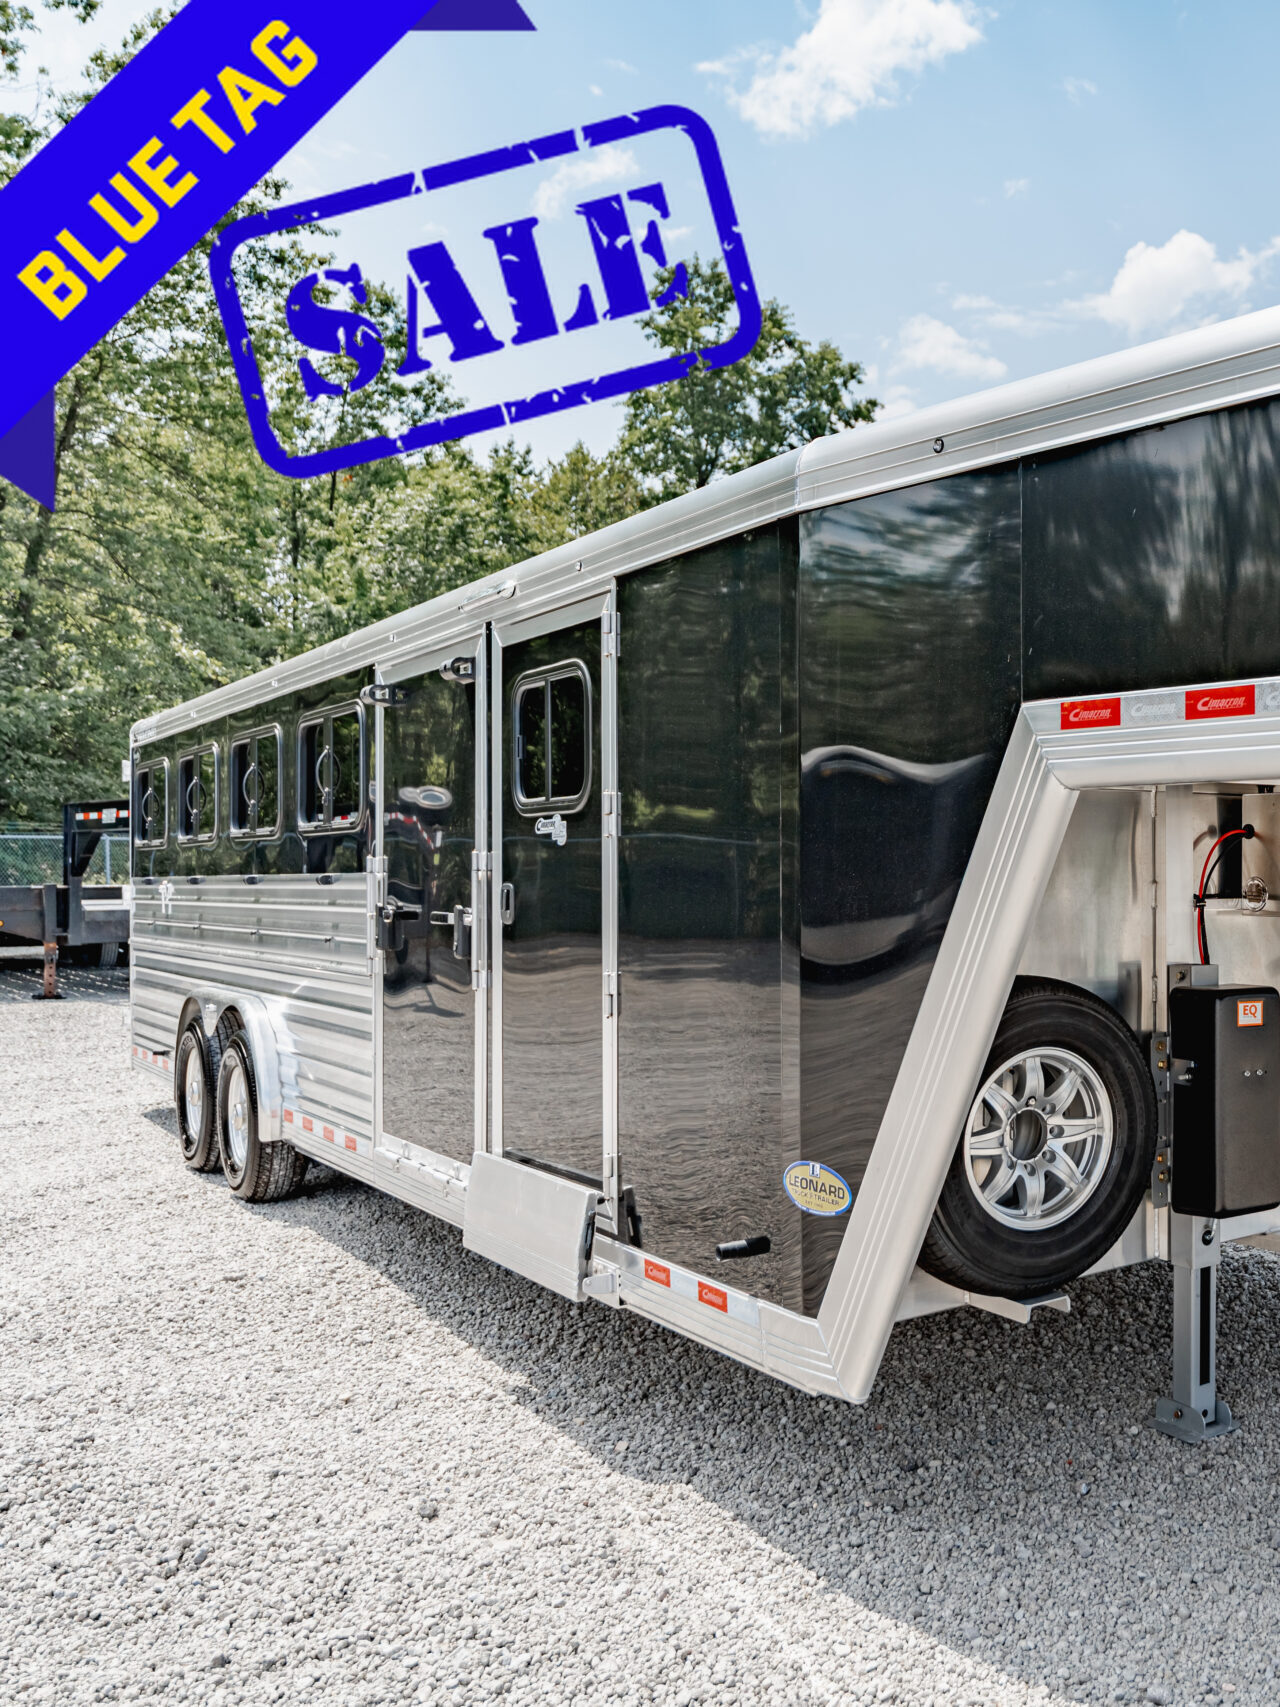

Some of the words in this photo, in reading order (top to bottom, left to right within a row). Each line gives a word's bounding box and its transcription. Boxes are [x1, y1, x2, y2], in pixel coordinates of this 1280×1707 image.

[1197, 696, 1246, 711] Cimarron
[1069, 708, 1112, 722] Cimarron
[1243, 1004, 1258, 1018] EQ
[789, 1173, 845, 1200] LEONARD
